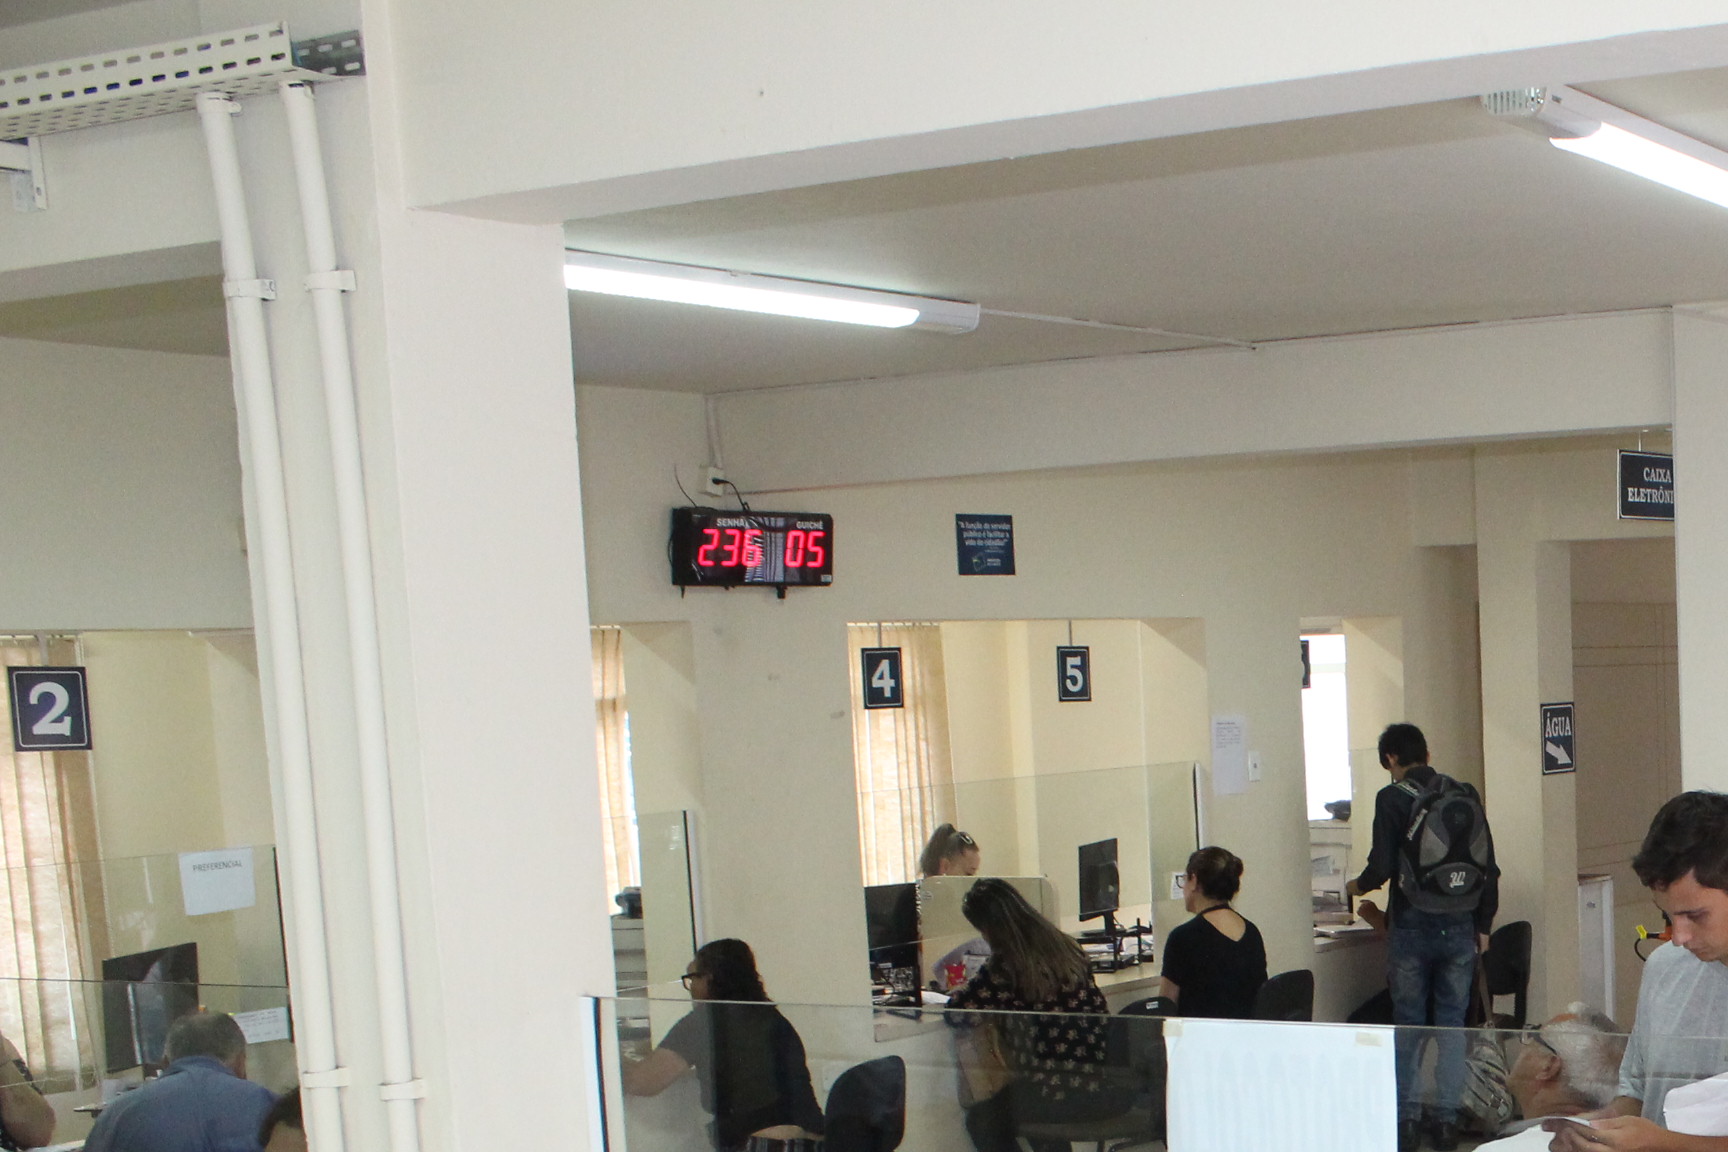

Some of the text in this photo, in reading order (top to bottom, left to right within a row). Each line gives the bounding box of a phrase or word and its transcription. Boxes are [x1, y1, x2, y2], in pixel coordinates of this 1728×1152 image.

[1643, 467, 1672, 483] CAIXA
[1627, 486, 1674, 504] ELETRÔNI
[717, 518, 745, 528] SENHA
[697, 528, 826, 568] 236 05
[871, 659, 896, 698] 4
[1065, 656, 1083, 692] 5
[29, 681, 72, 736] 2
[1545, 711, 1572, 738] ÁGUA
[192, 859, 242, 872] PREFERENCIAL
